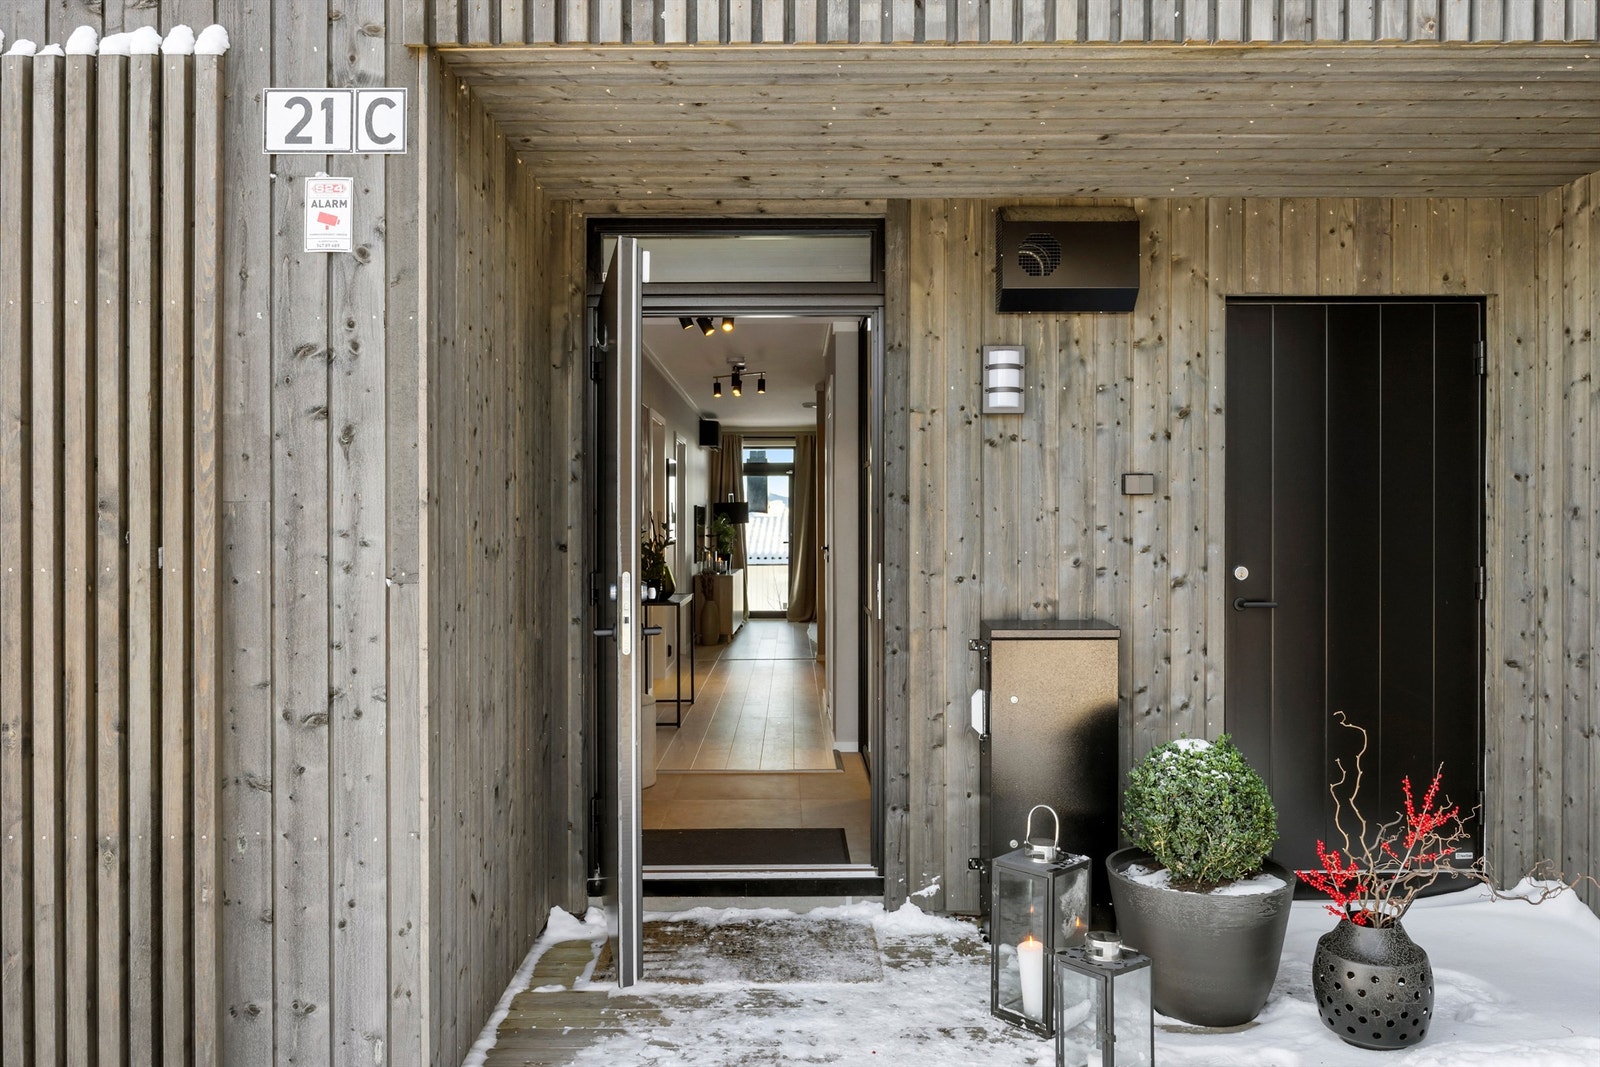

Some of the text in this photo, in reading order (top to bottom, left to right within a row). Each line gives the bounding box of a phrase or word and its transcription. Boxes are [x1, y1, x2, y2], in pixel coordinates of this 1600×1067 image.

[284, 96, 397, 145] 21 C
[314, 184, 344, 193] S24
[311, 199, 348, 209] ALARM
